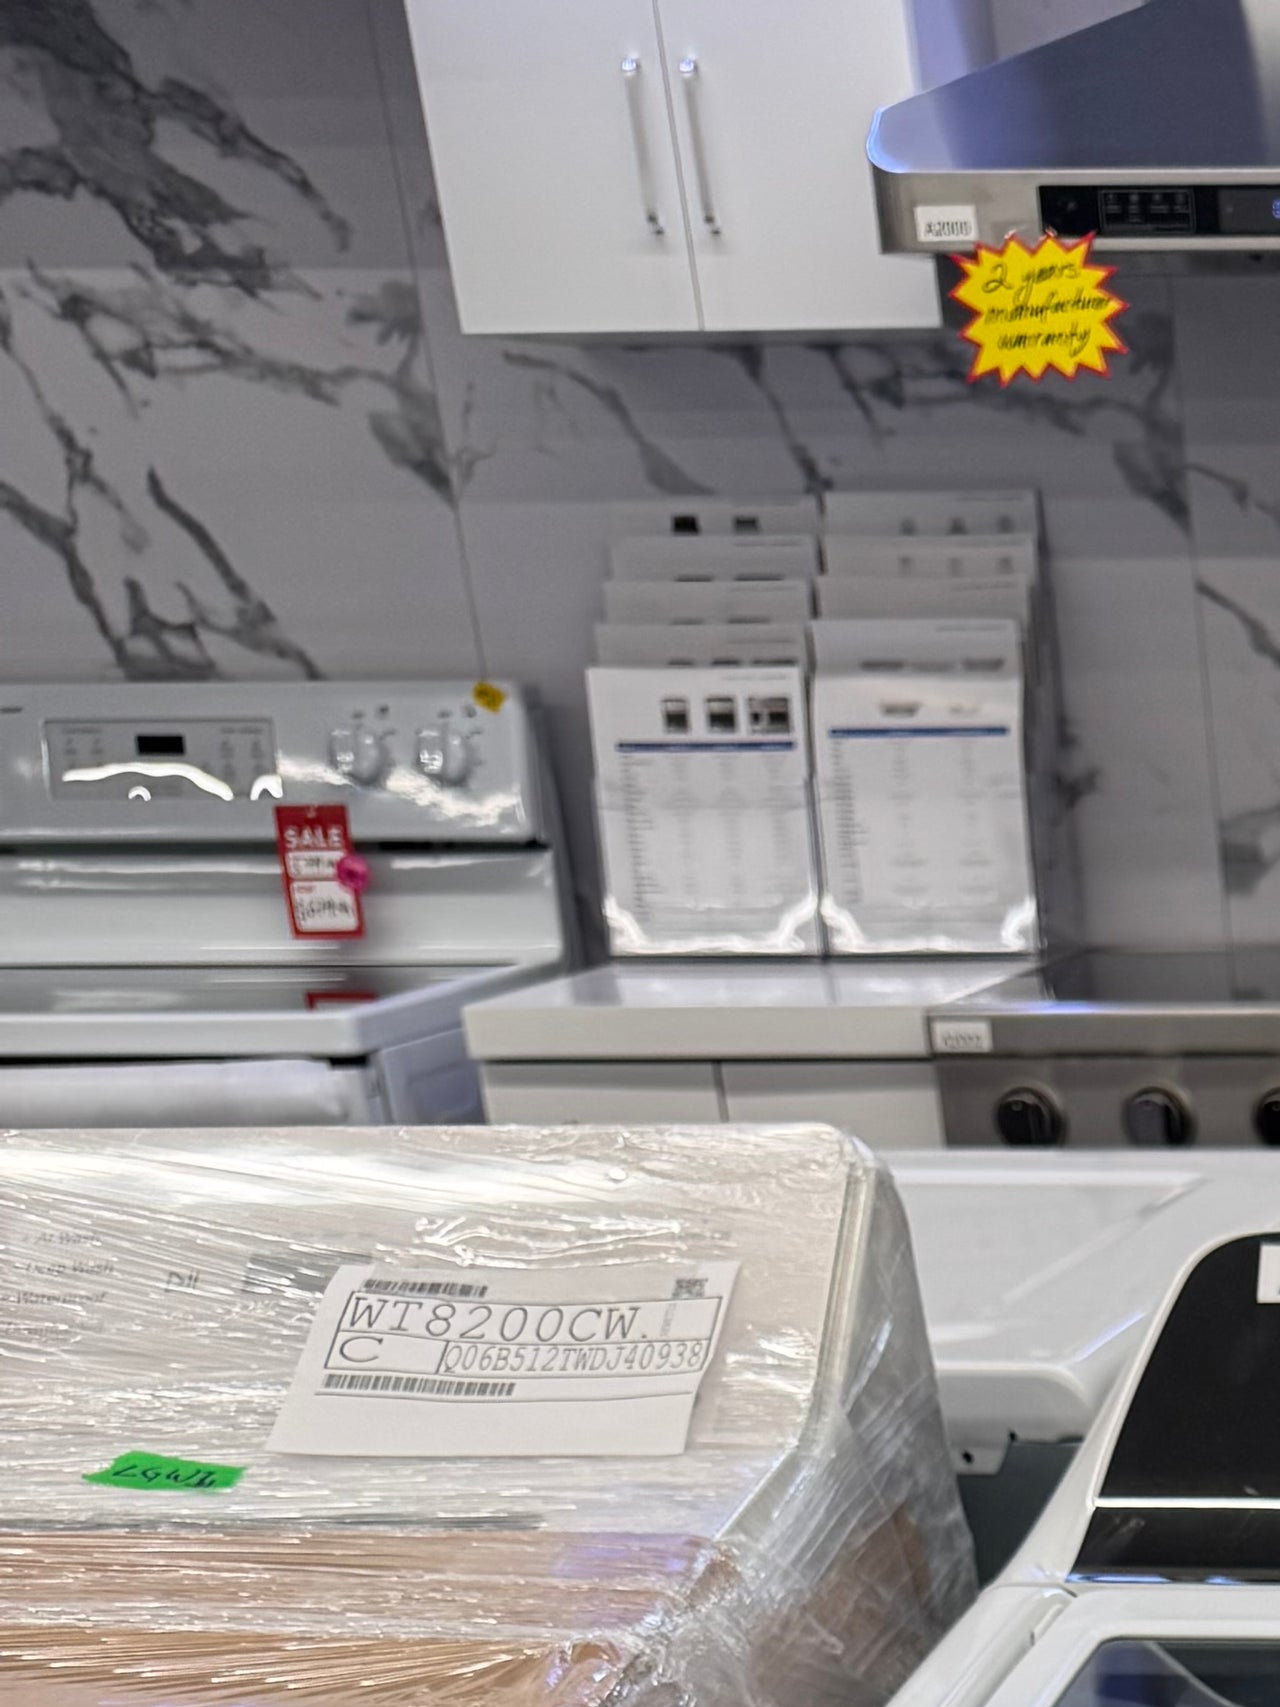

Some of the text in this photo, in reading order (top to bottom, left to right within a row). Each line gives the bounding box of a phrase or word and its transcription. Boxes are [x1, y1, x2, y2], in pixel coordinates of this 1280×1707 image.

[982, 263, 1014, 294] 2
[283, 824, 345, 849] SALE
[339, 1336, 384, 1364] C
